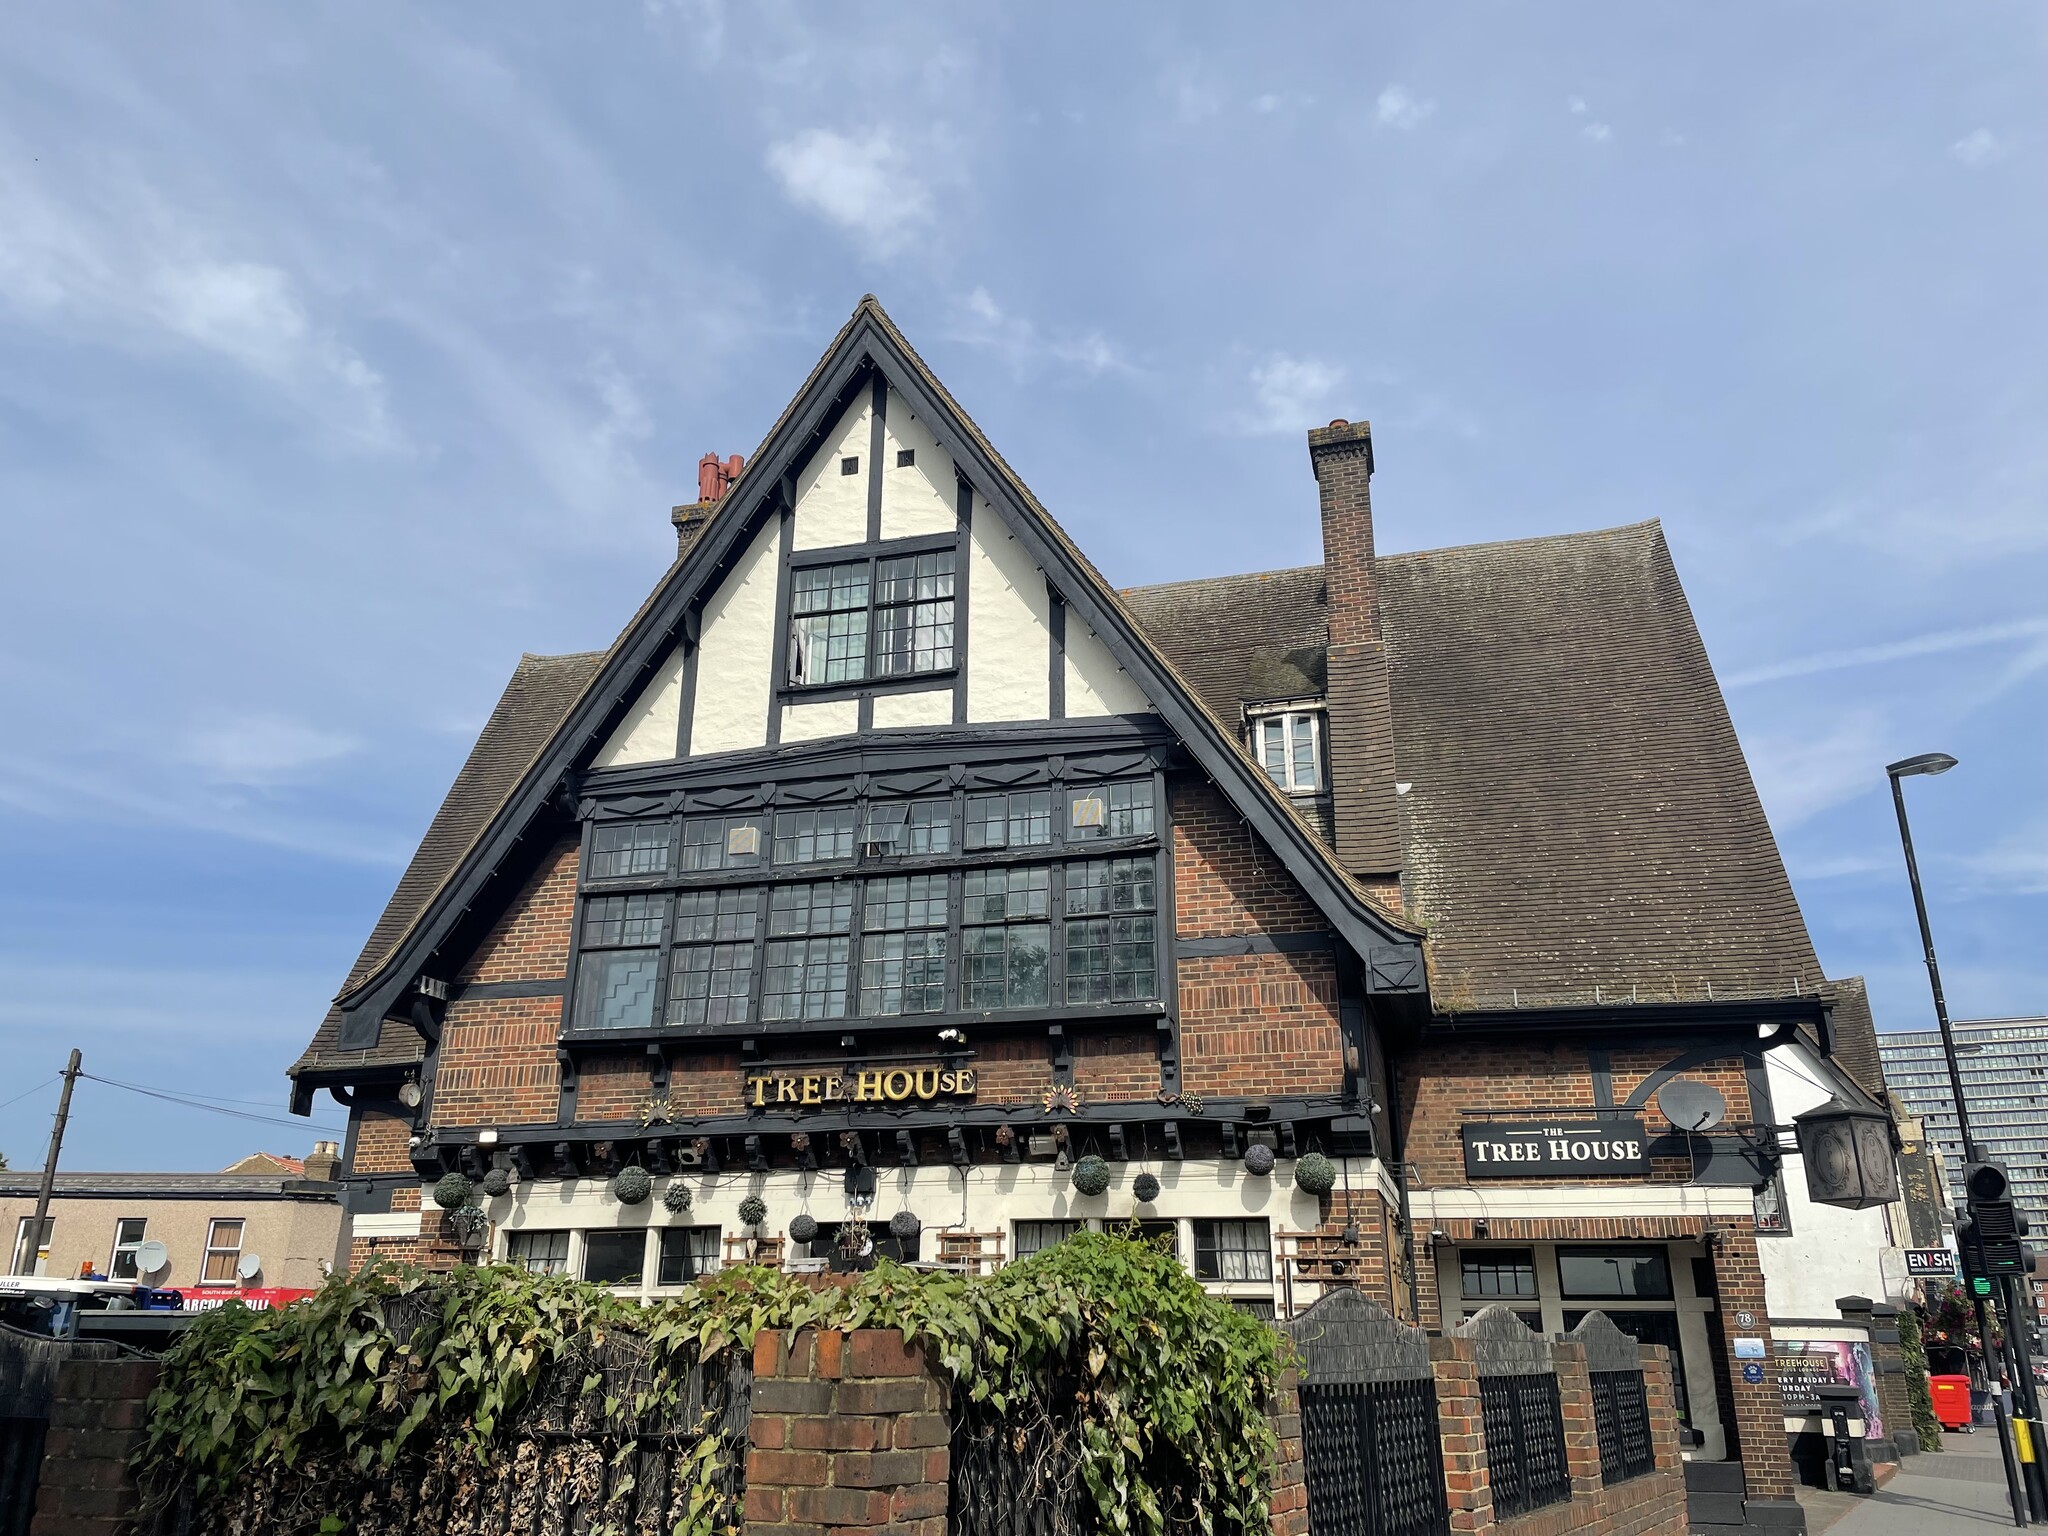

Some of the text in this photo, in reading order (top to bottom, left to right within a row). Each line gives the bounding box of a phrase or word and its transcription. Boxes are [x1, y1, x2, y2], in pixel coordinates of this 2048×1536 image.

[748, 1068, 975, 1106] TREE HOUSE
[1543, 1128, 1563, 1136] THE
[1472, 1140, 1642, 1162] TREE HOUSE
[1738, 1313, 1752, 1323] 78
[1775, 1359, 1824, 1367] TREEHOUSE
[1798, 1376, 1827, 1384] FRIDAY
[1782, 1393, 1821, 1401] 10PM-3A
